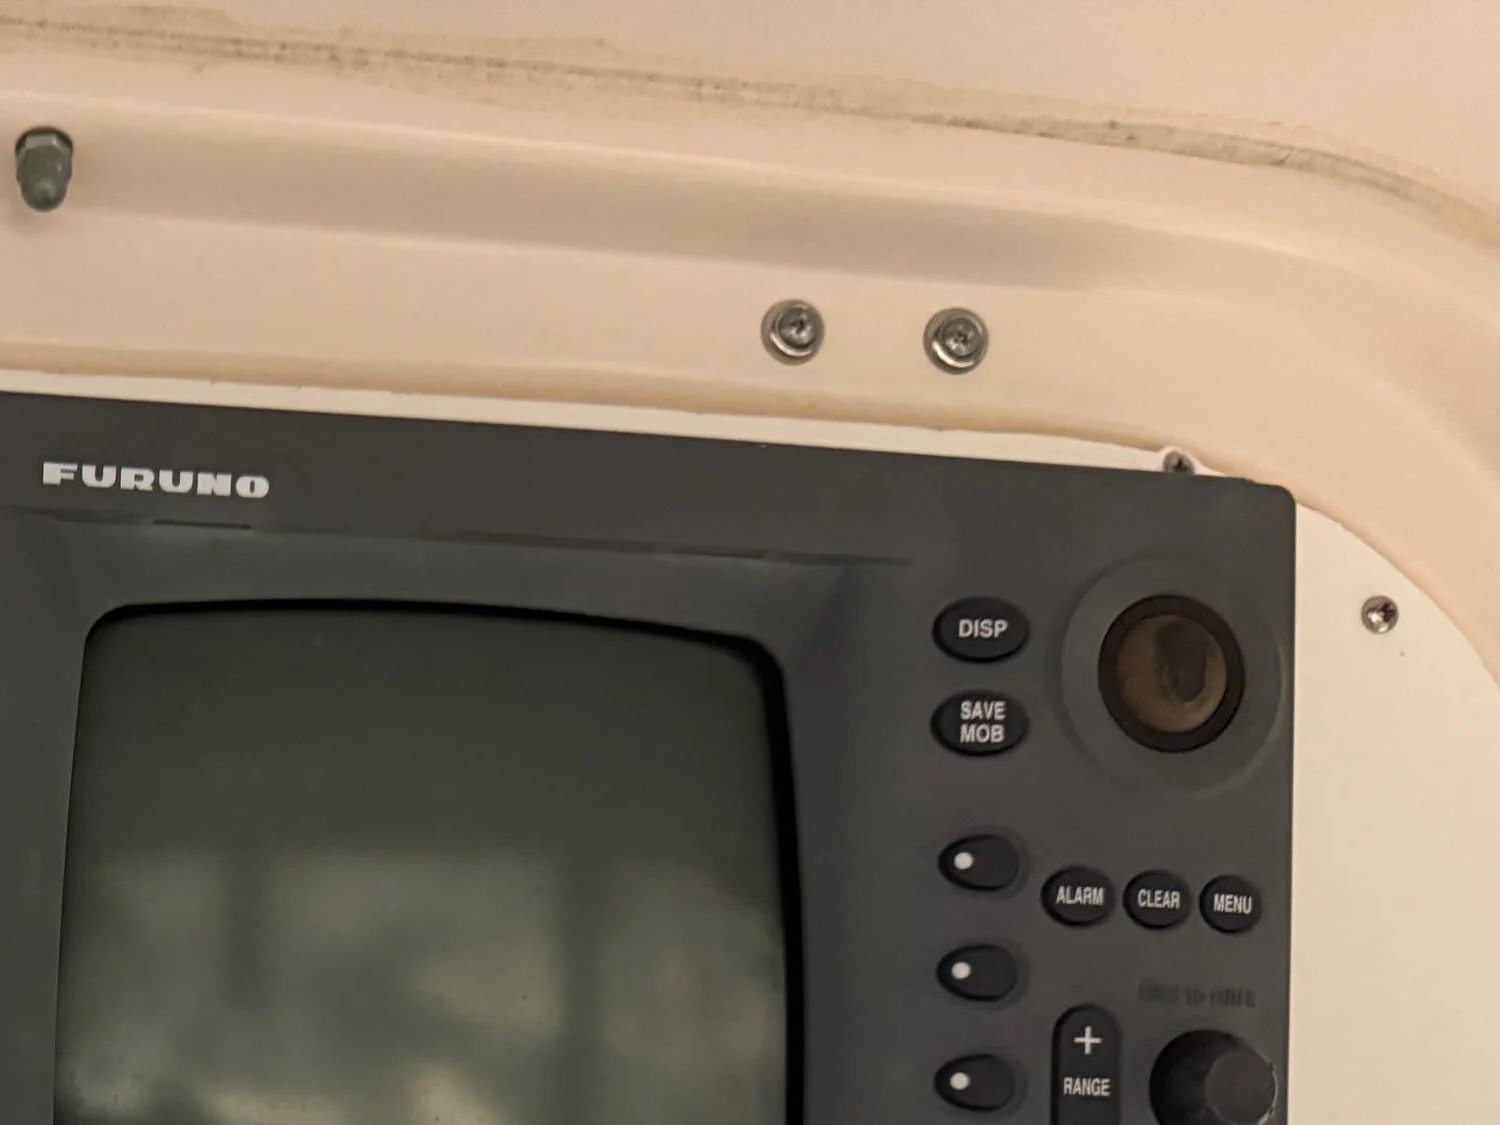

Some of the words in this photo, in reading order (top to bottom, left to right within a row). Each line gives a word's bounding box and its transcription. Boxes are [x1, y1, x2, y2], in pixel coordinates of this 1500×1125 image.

[43, 461, 270, 498] FURUNO
[958, 619, 1008, 639] DISP
[960, 700, 1006, 721] SAVE
[960, 723, 1005, 744] MOB
[1056, 885, 1105, 905] ALARM
[1137, 888, 1181, 910] CLEAR
[1213, 892, 1253, 915] MENU
[1063, 1076, 1111, 1097] RANGE
